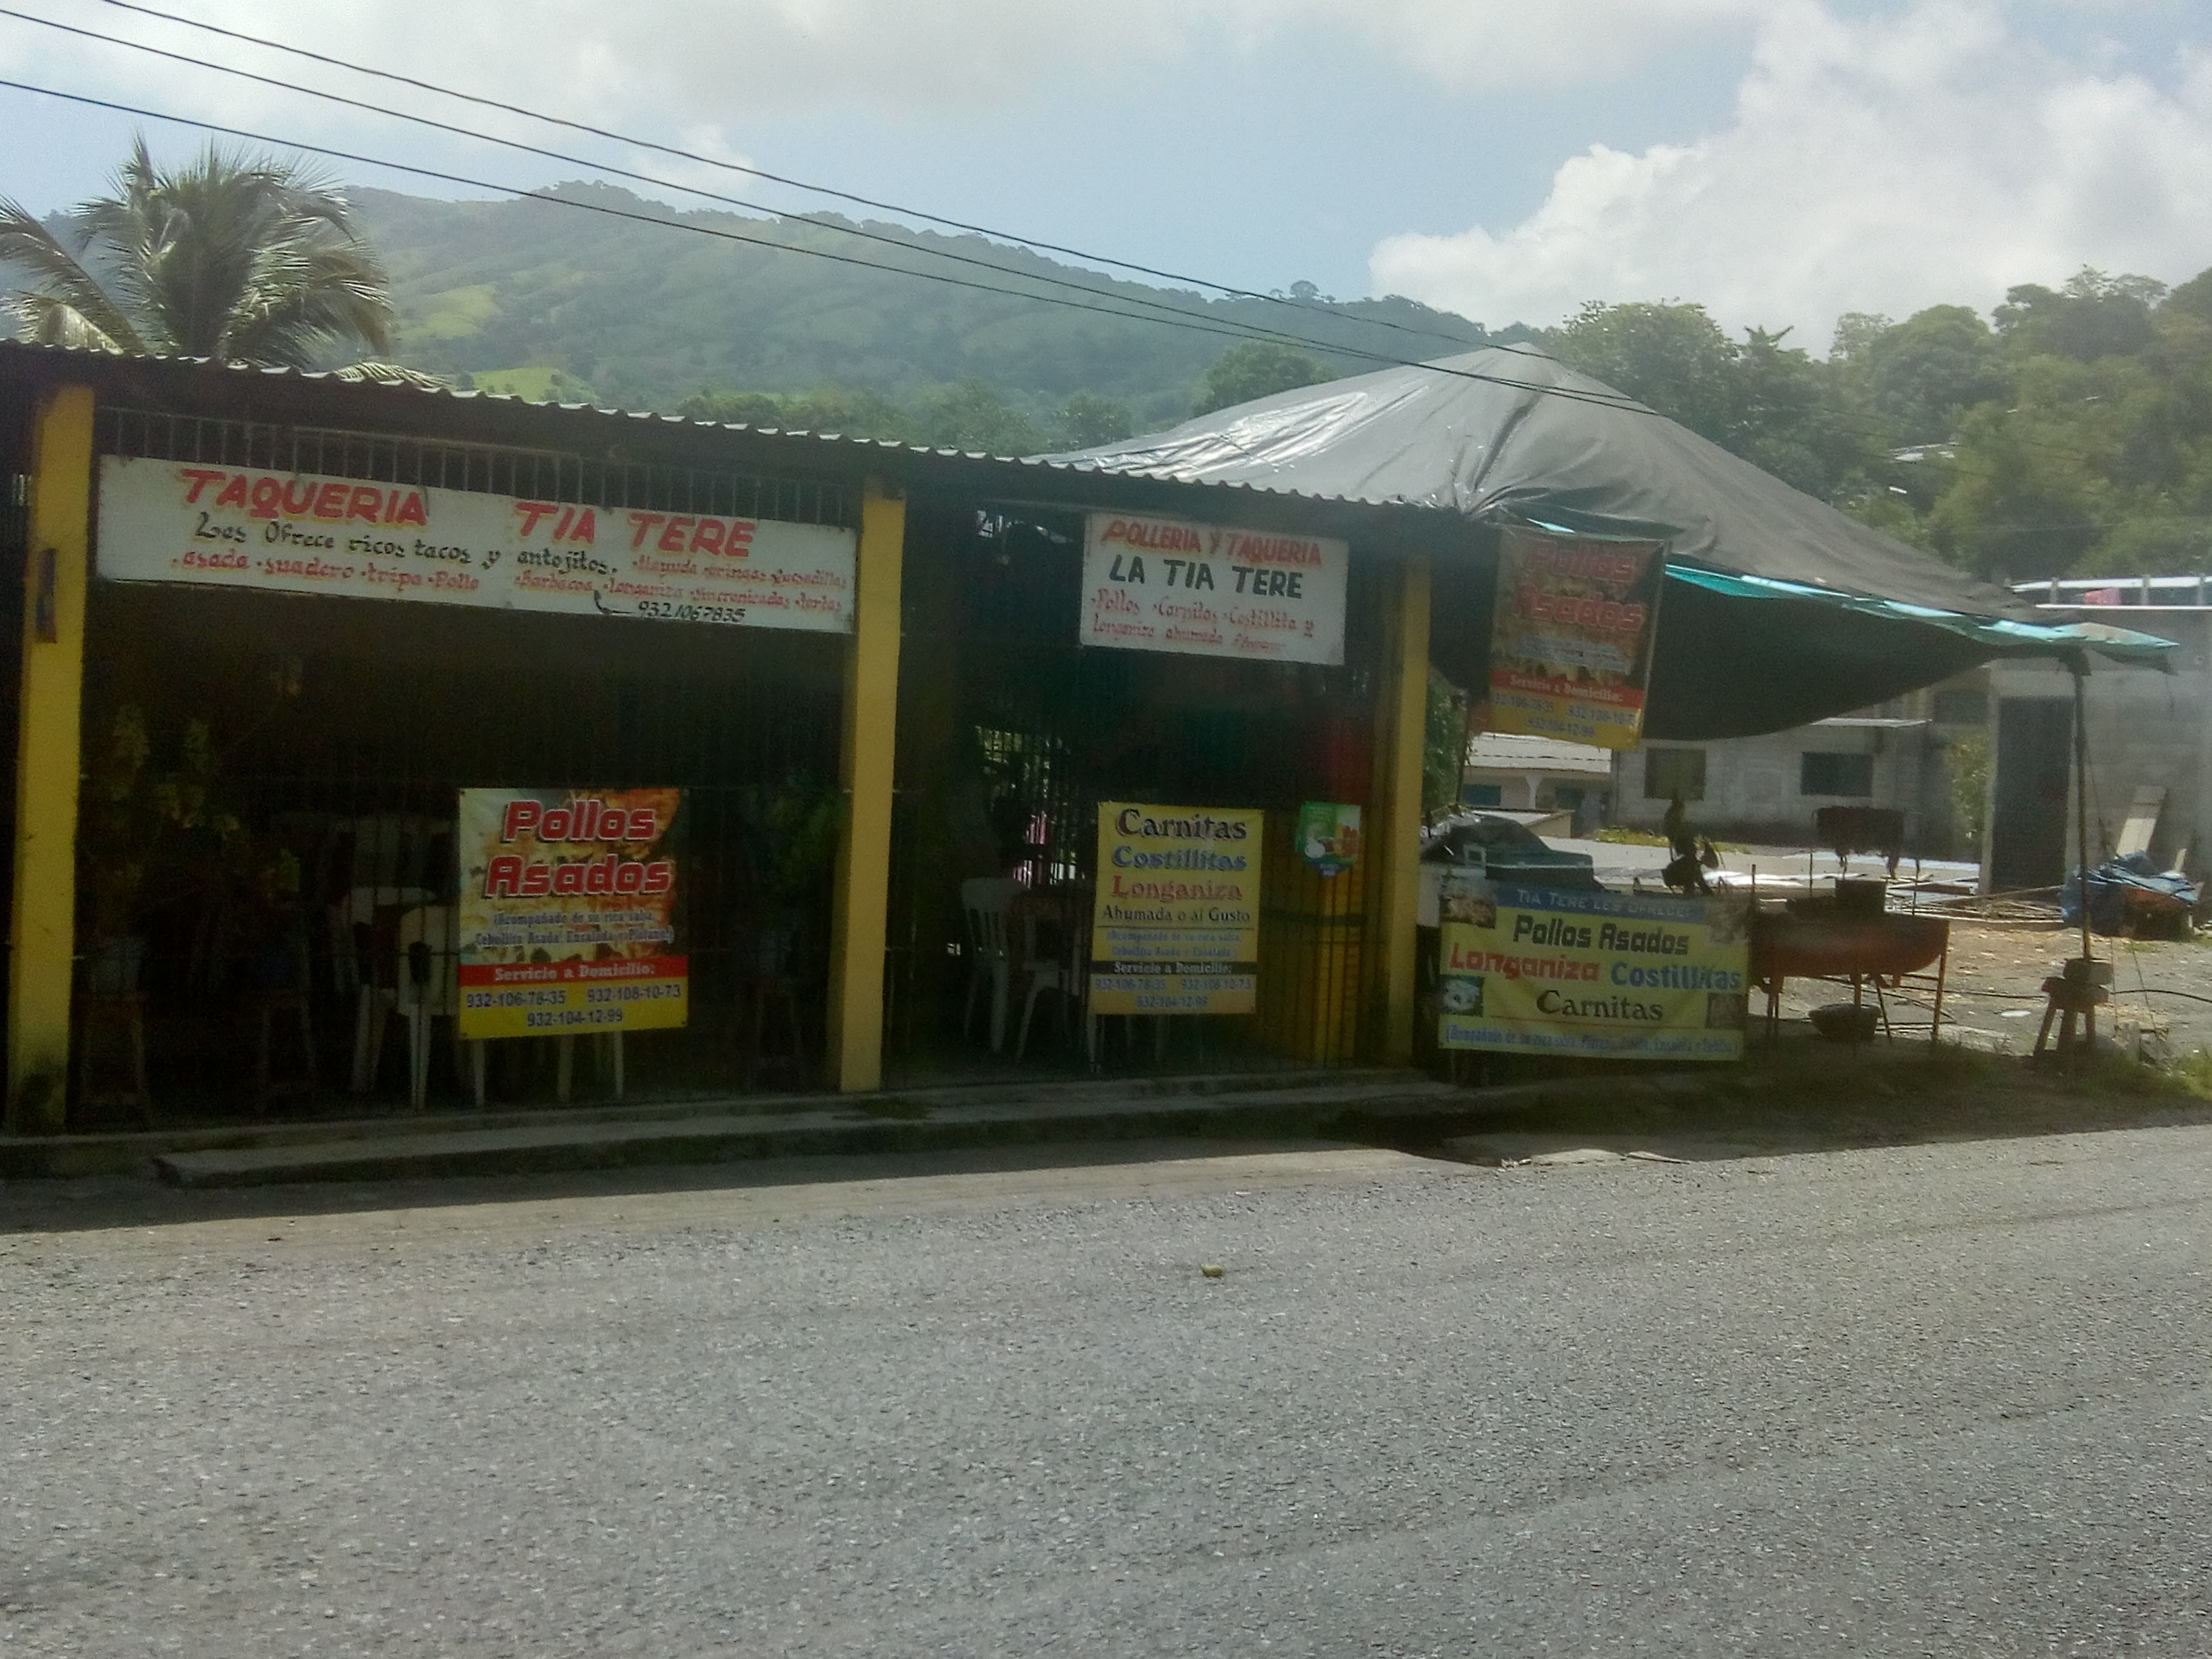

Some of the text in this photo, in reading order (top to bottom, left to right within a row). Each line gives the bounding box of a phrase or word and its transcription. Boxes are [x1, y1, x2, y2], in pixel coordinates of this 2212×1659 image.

[180, 468, 756, 557] TAQUERIA TIA TERE
[348, 534, 406, 558] ricos
[413, 539, 472, 564] tacos
[480, 550, 501, 571] y
[1101, 520, 1322, 565] POLLERIA Y TAQUERIA
[1109, 554, 1303, 598] LA TIA TERE
[501, 798, 657, 842] Pollos
[1115, 808, 1247, 840] Carnitas
[483, 853, 672, 899] Asados
[1111, 844, 1247, 872] Costillitas
[1111, 874, 1244, 903] Longaniza
[1103, 904, 1250, 922] Ahumada o al Gusto
[1512, 914, 1689, 956] Pollos Asados
[494, 966, 558, 981] Servicio
[563, 968, 574, 979] a
[1450, 942, 1741, 990] Longaniza Costillitas
[1536, 989, 1664, 1021] Carnitas
